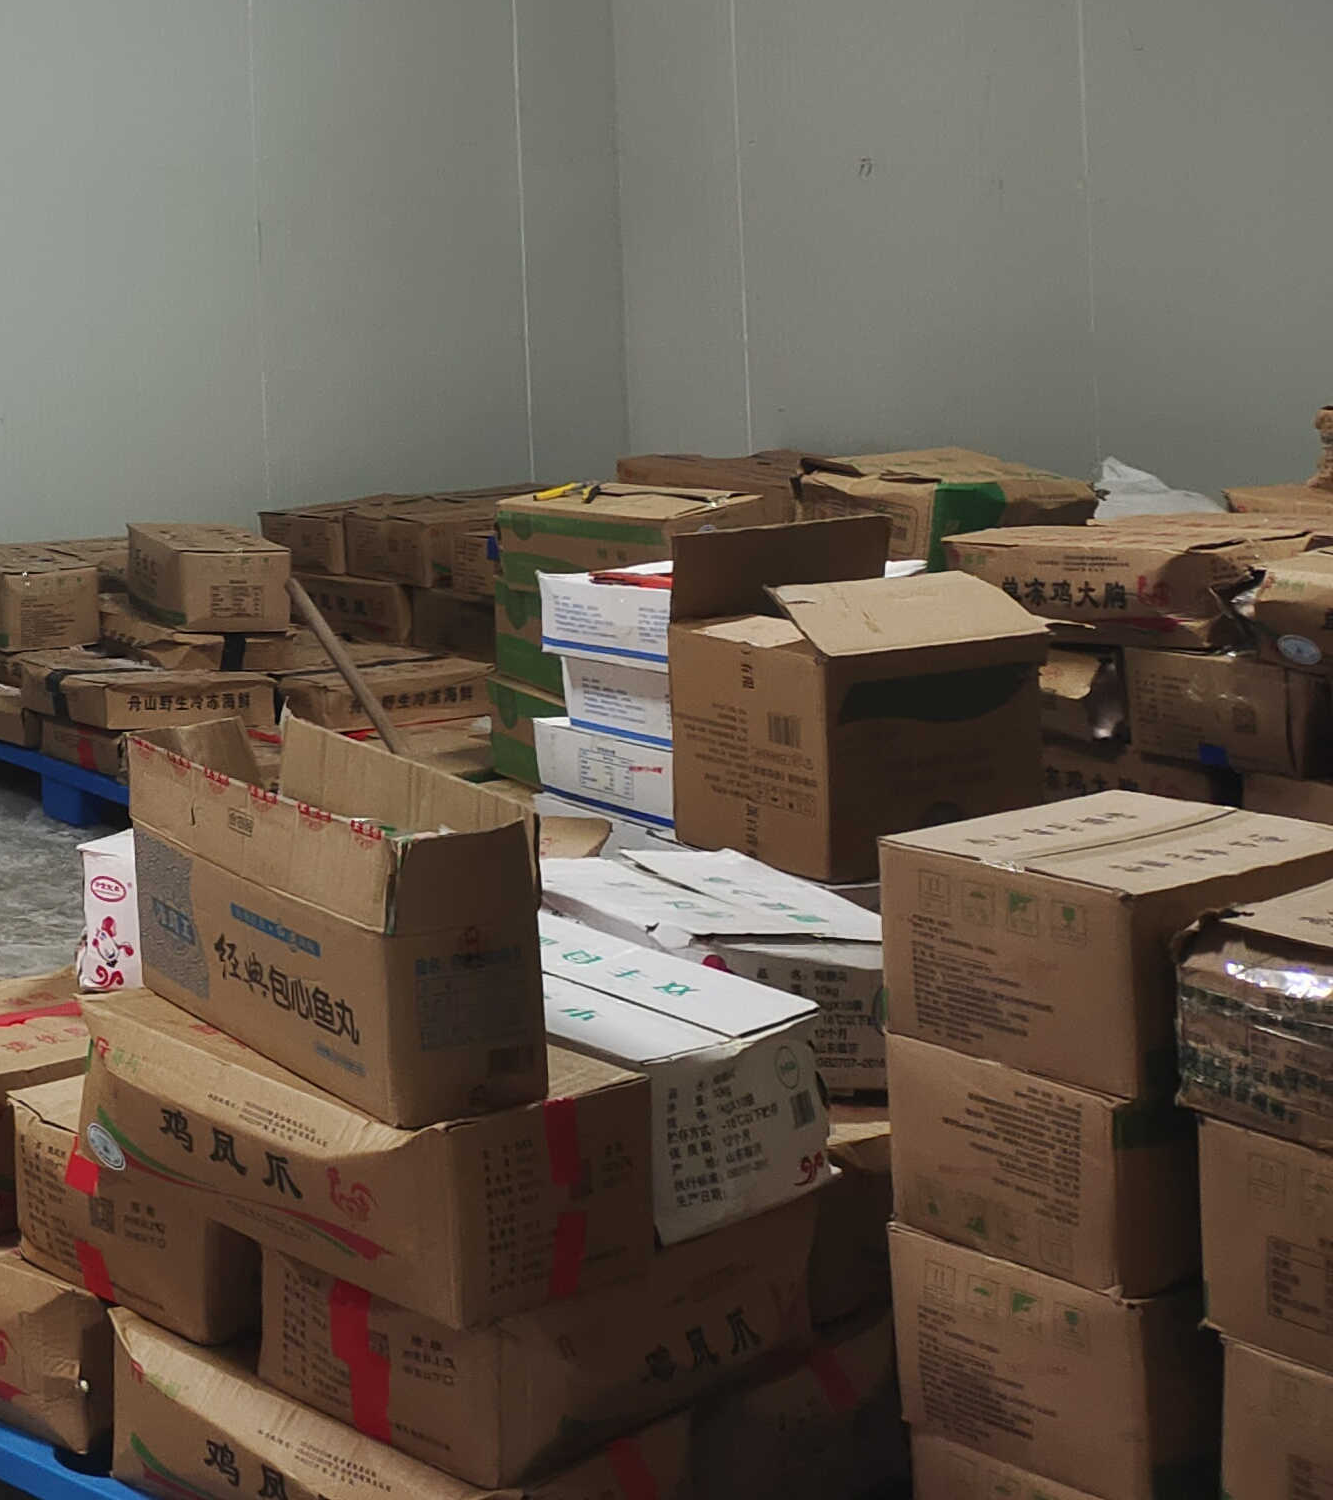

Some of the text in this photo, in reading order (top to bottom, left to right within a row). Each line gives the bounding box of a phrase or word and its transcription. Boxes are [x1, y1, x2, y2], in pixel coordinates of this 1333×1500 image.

[160, 1107, 303, 1199] 鸡凤爪
[204, 1439, 330, 1500] 鸡凤
